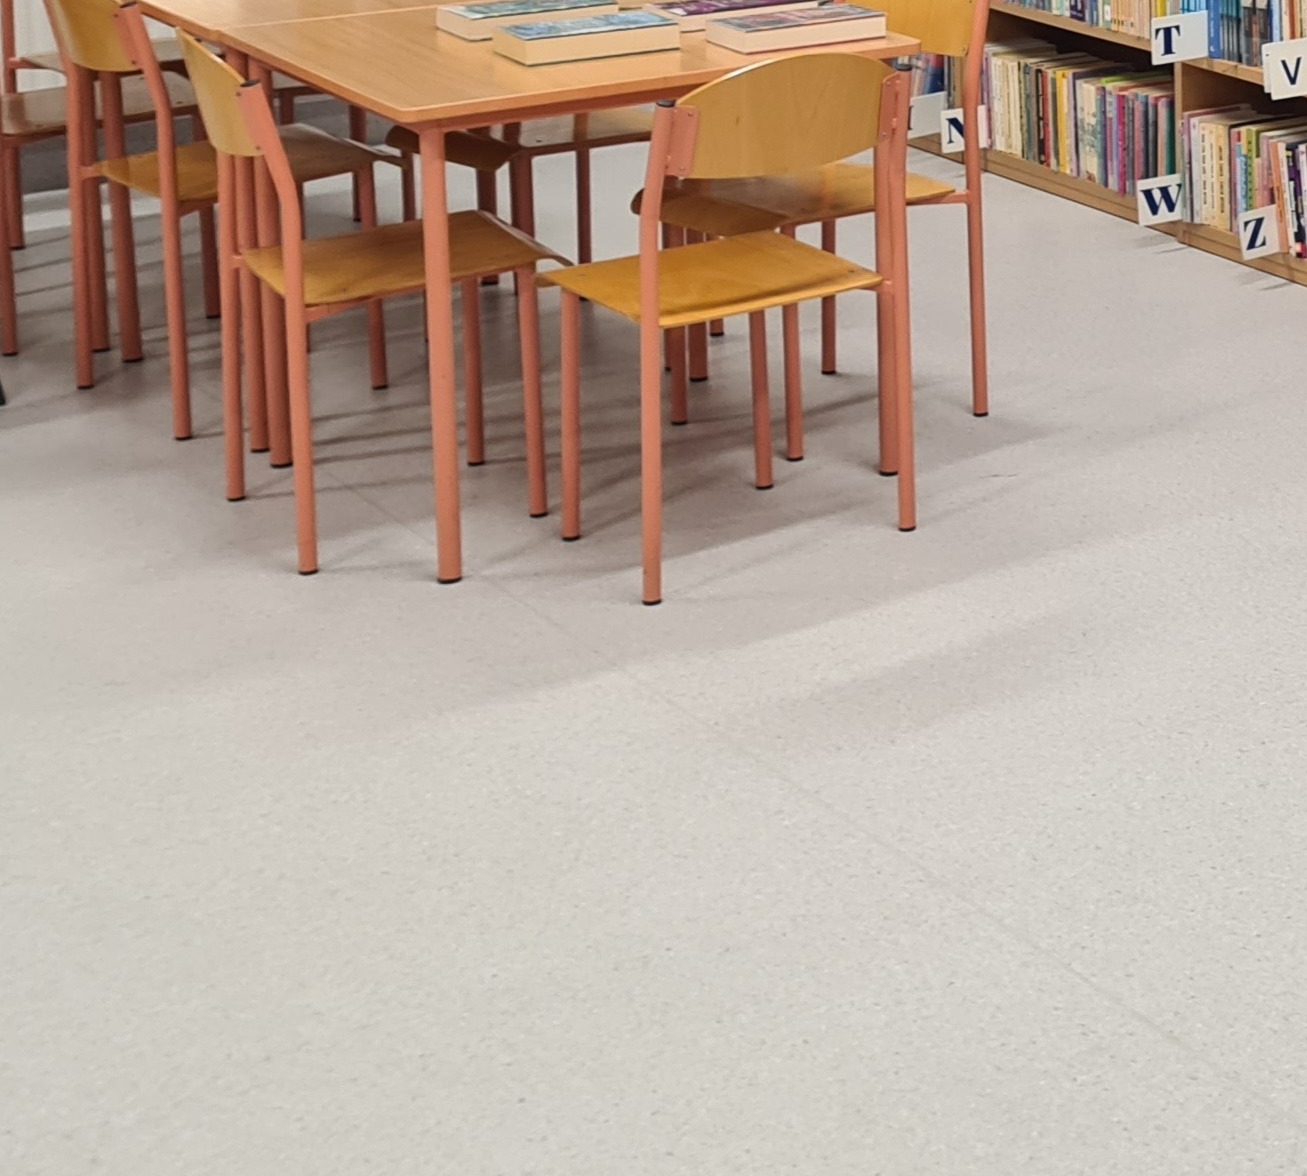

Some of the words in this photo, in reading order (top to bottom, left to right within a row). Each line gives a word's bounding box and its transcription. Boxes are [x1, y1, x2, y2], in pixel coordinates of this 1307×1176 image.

[1152, 23, 1182, 57] T
[1280, 56, 1302, 86] V
[1140, 183, 1182, 215] W
[1243, 216, 1267, 251] Z
